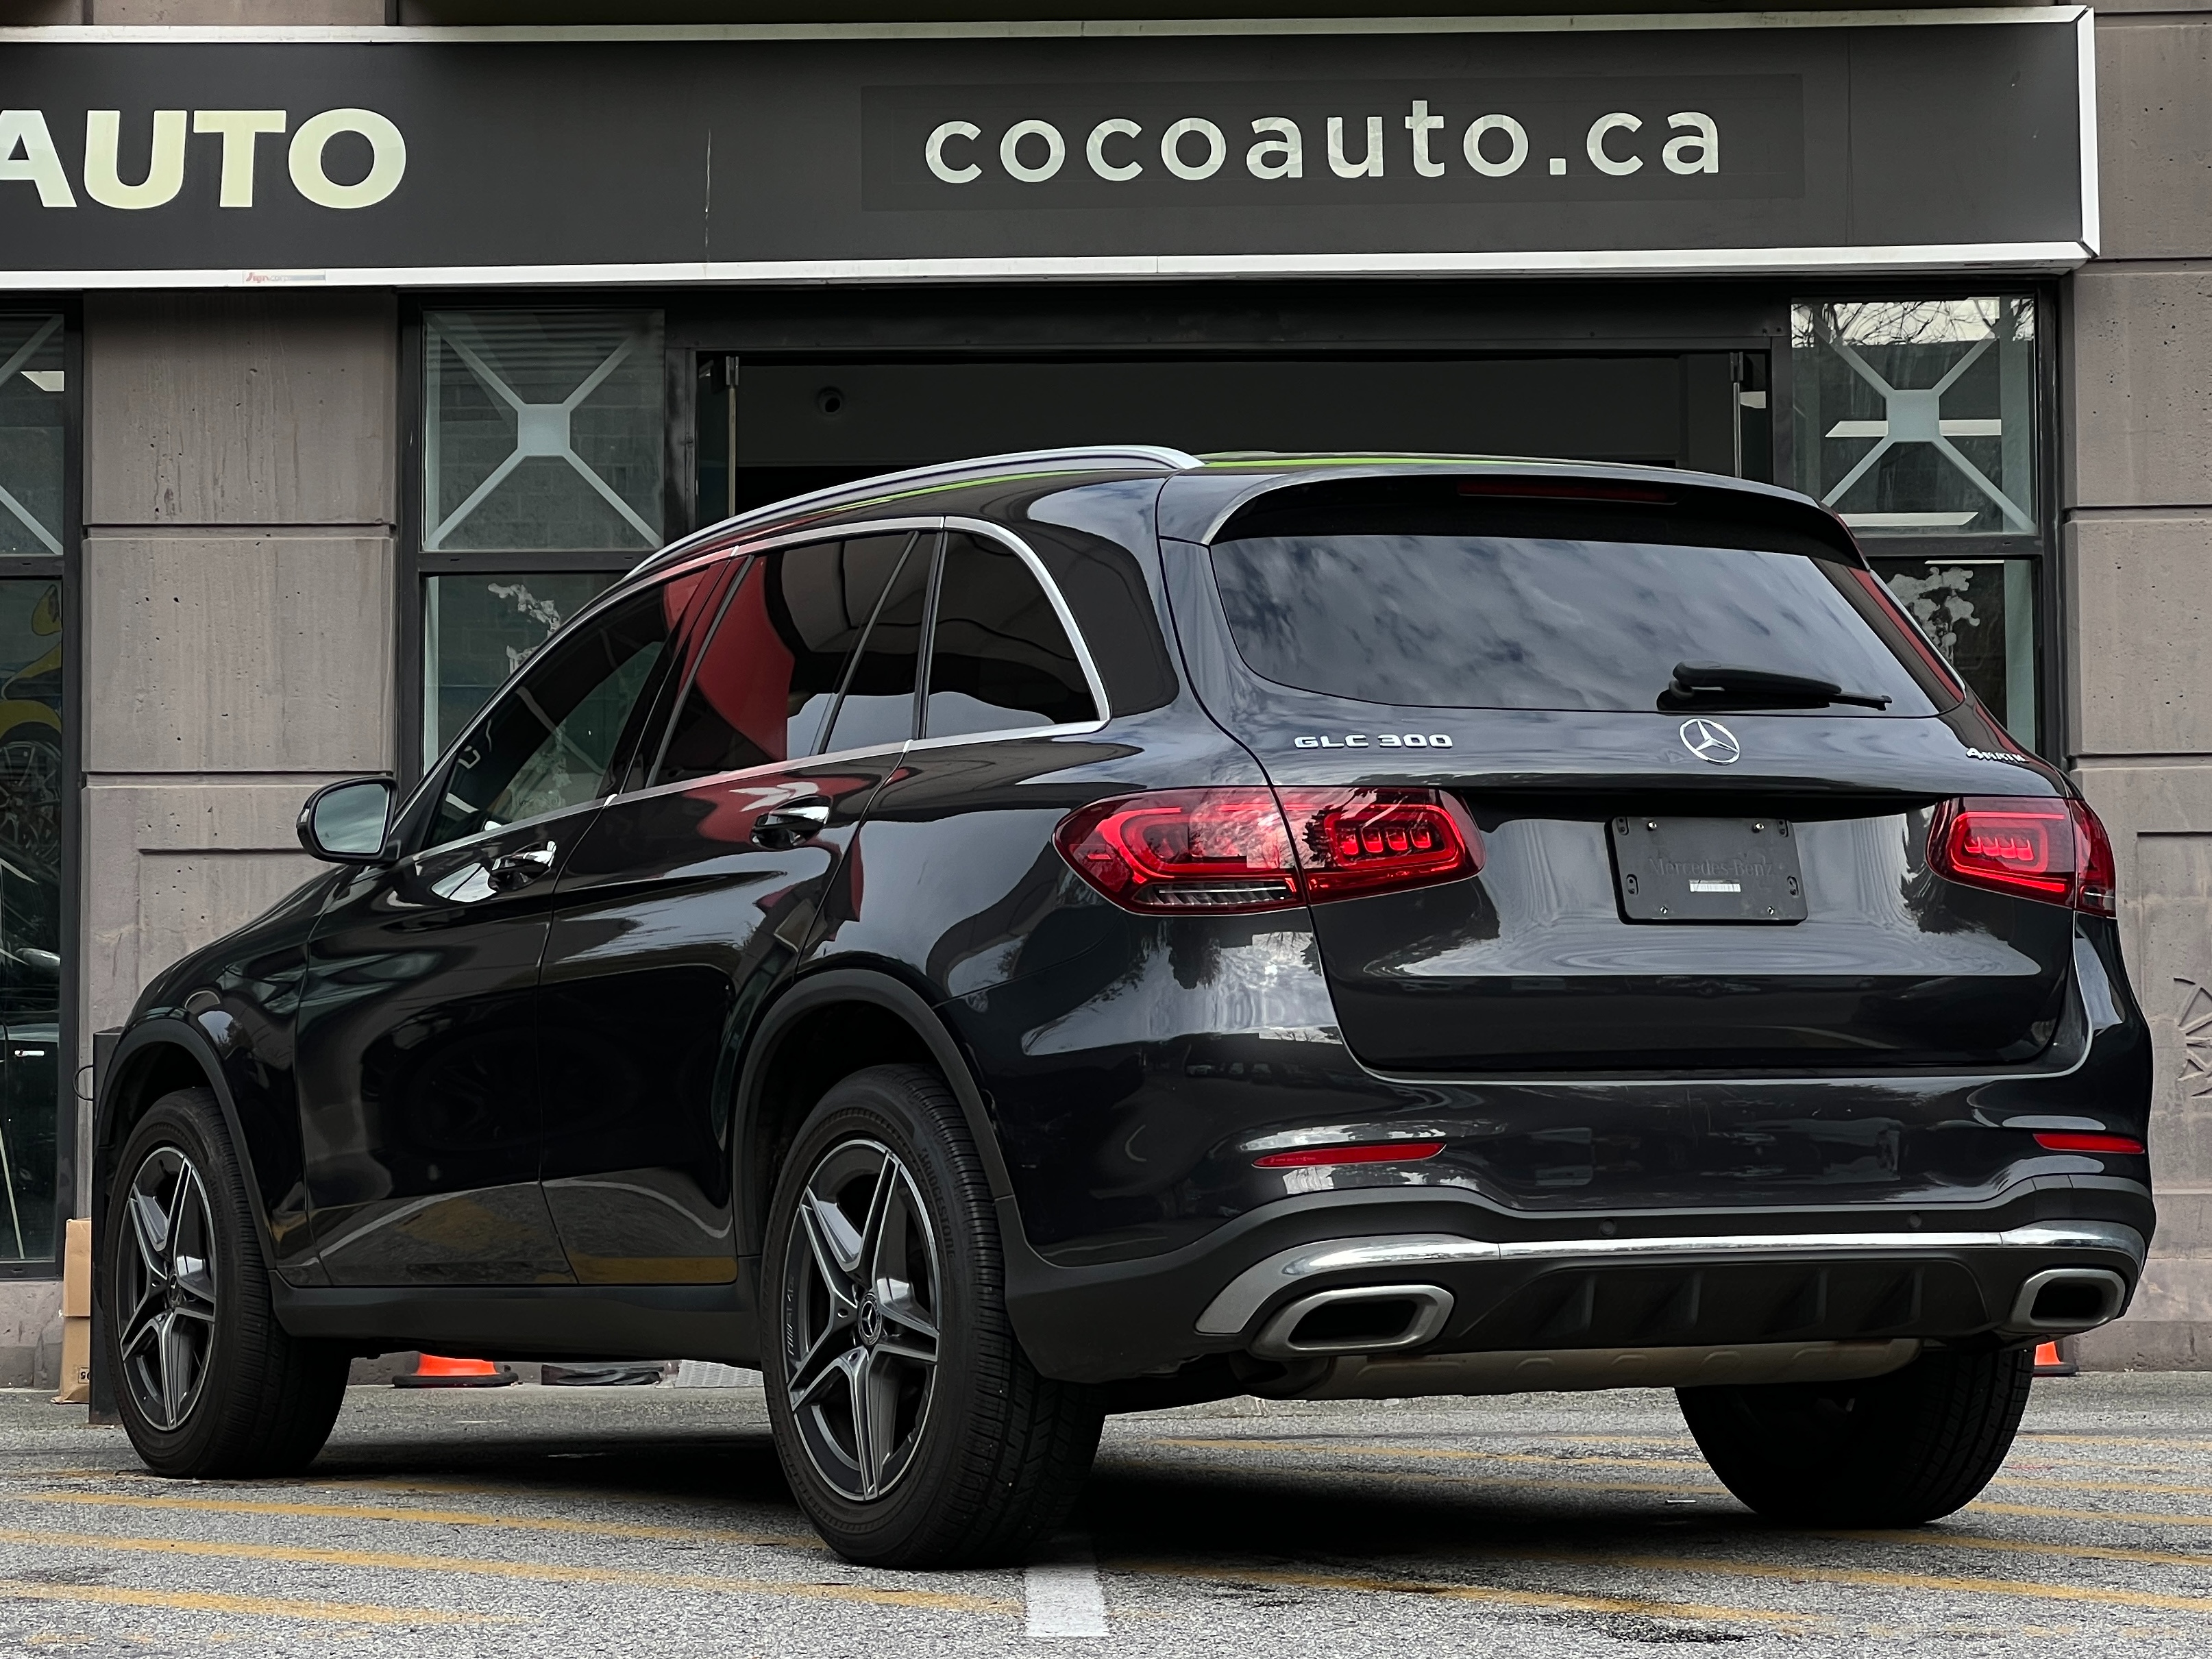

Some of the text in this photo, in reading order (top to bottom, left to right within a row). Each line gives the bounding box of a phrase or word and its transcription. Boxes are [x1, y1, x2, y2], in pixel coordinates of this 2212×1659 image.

[0, 108, 407, 210] AUTO
[924, 99, 1722, 184] cocoauto.ca
[1294, 734, 1453, 749] GLC 300
[1648, 857, 1775, 877] Mercedes-Benz
